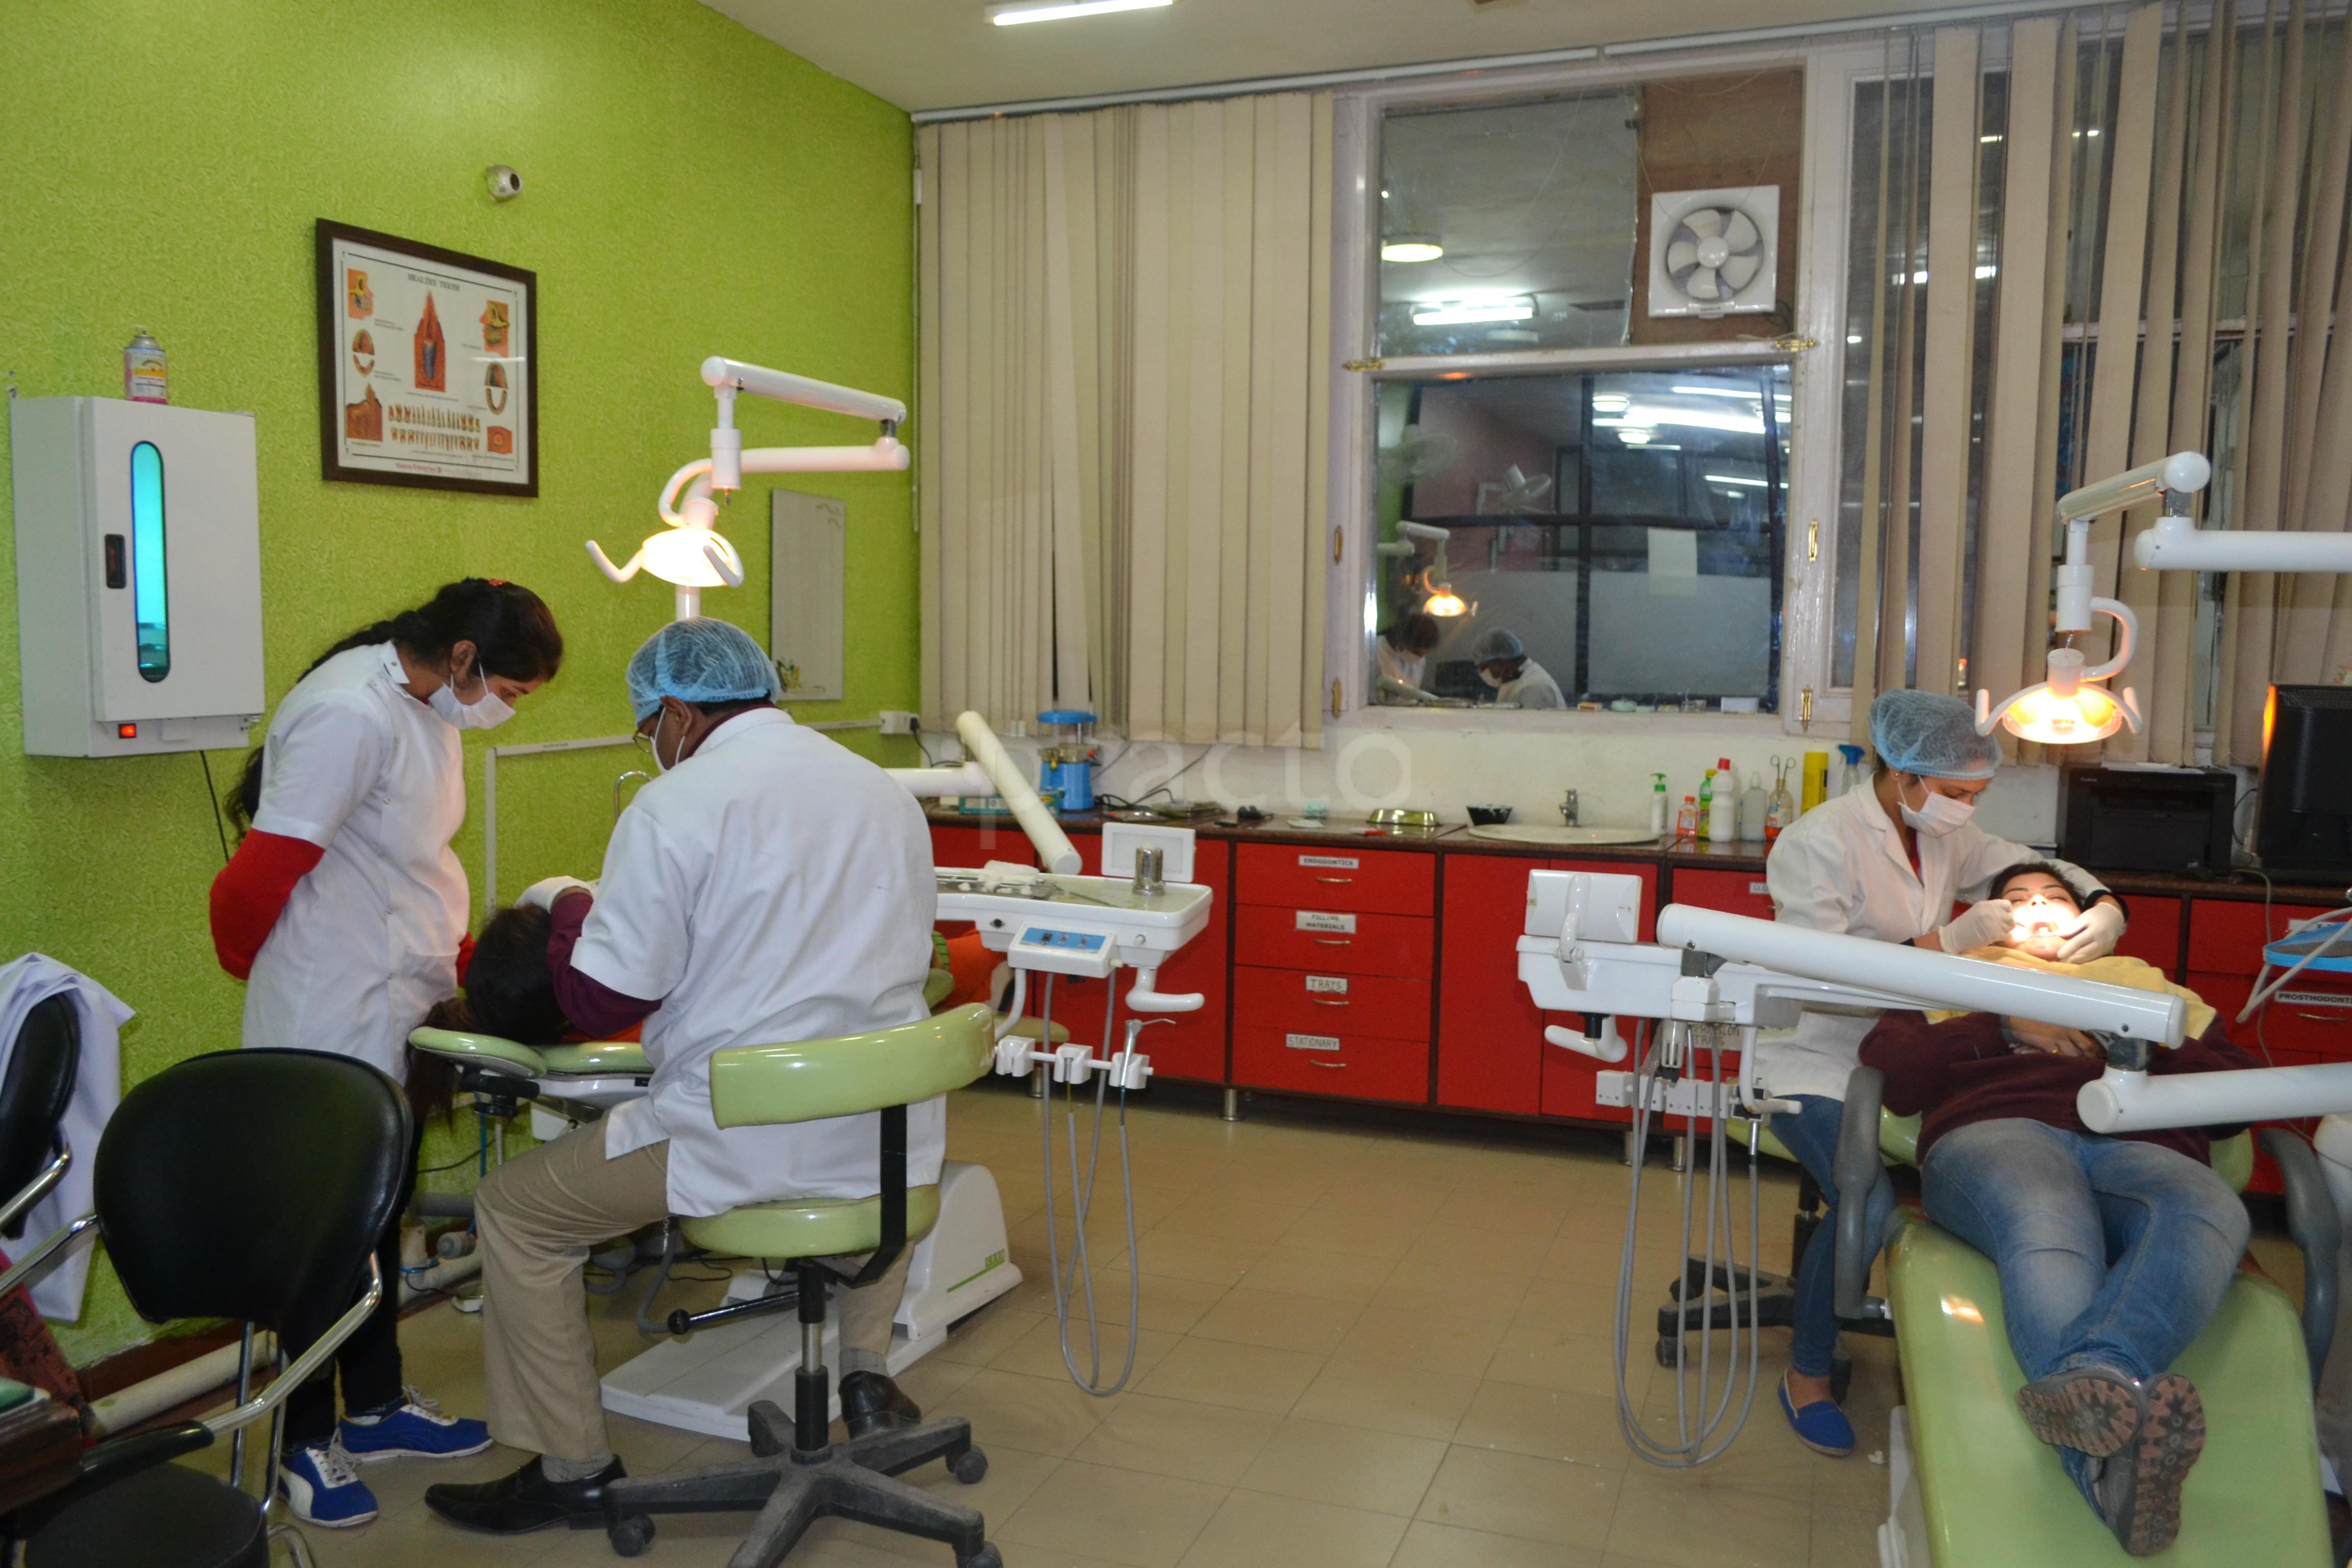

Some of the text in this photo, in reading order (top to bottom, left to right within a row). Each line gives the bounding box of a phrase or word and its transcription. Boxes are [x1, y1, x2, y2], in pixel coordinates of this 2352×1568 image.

[407, 273, 460, 291] HEALTHY TEETH
[1304, 857, 1353, 866] ENDODONTICS
[1310, 978, 1342, 989] TRAYS
[1288, 1036, 1337, 1046] STATIONARY
